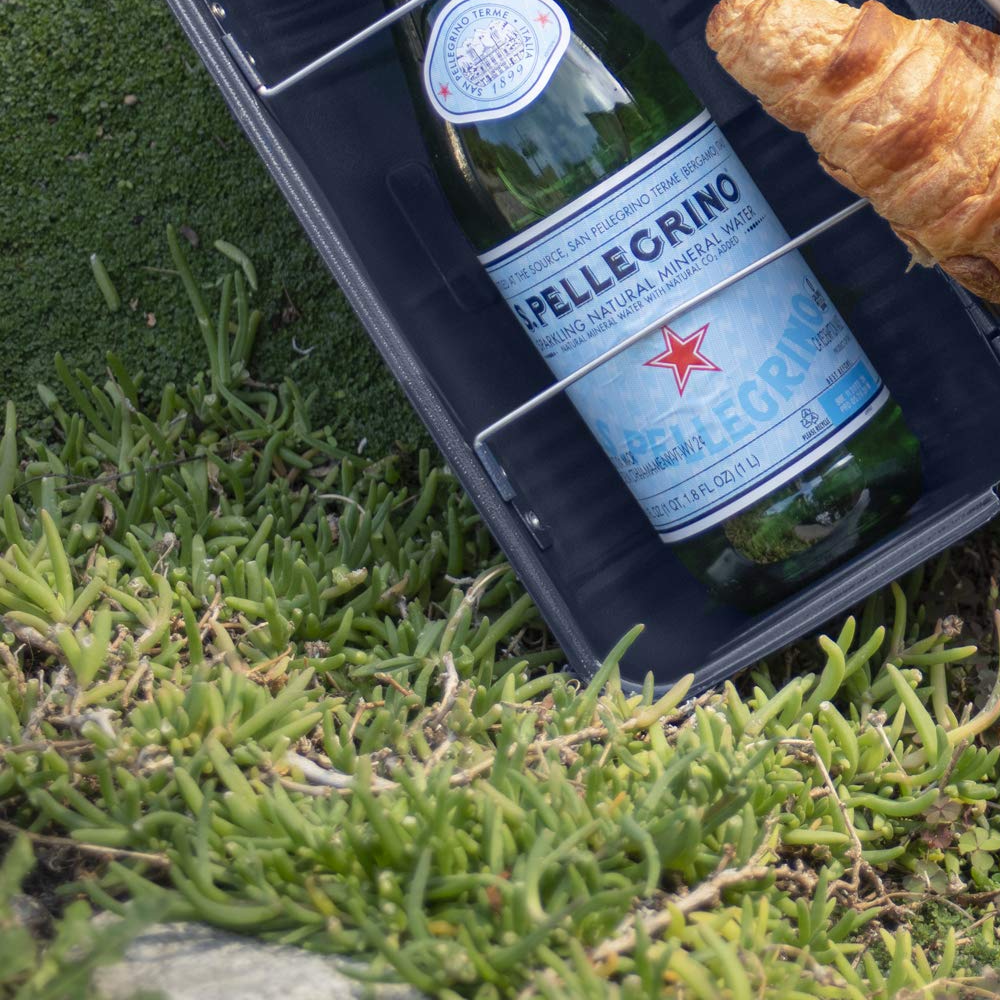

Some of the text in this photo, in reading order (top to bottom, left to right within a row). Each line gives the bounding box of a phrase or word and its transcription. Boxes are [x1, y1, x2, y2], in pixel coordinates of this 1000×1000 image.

[447, 8, 534, 97] SAN PELLEGRINO TERME ITALIA
[514, 174, 741, 332] S.PELLEGRINO
[527, 244, 569, 275] SOURCE,
[566, 231, 591, 252] SAN
[589, 192, 651, 237] PELLEGRINO
[649, 172, 681, 198] TERME
[586, 275, 655, 324] NATURAL
[655, 231, 722, 282] MINERAL
[720, 204, 756, 236] WATER
[585, 315, 618, 339] MINERAL
[616, 299, 644, 321] WATER
[643, 285, 666, 304] WITH
[664, 262, 702, 290] NATURAL
[715, 234, 740, 256] ADDED
[683, 489, 700, 505] 1.8
[698, 481, 715, 497] FL
[713, 468, 736, 487] OZ)
